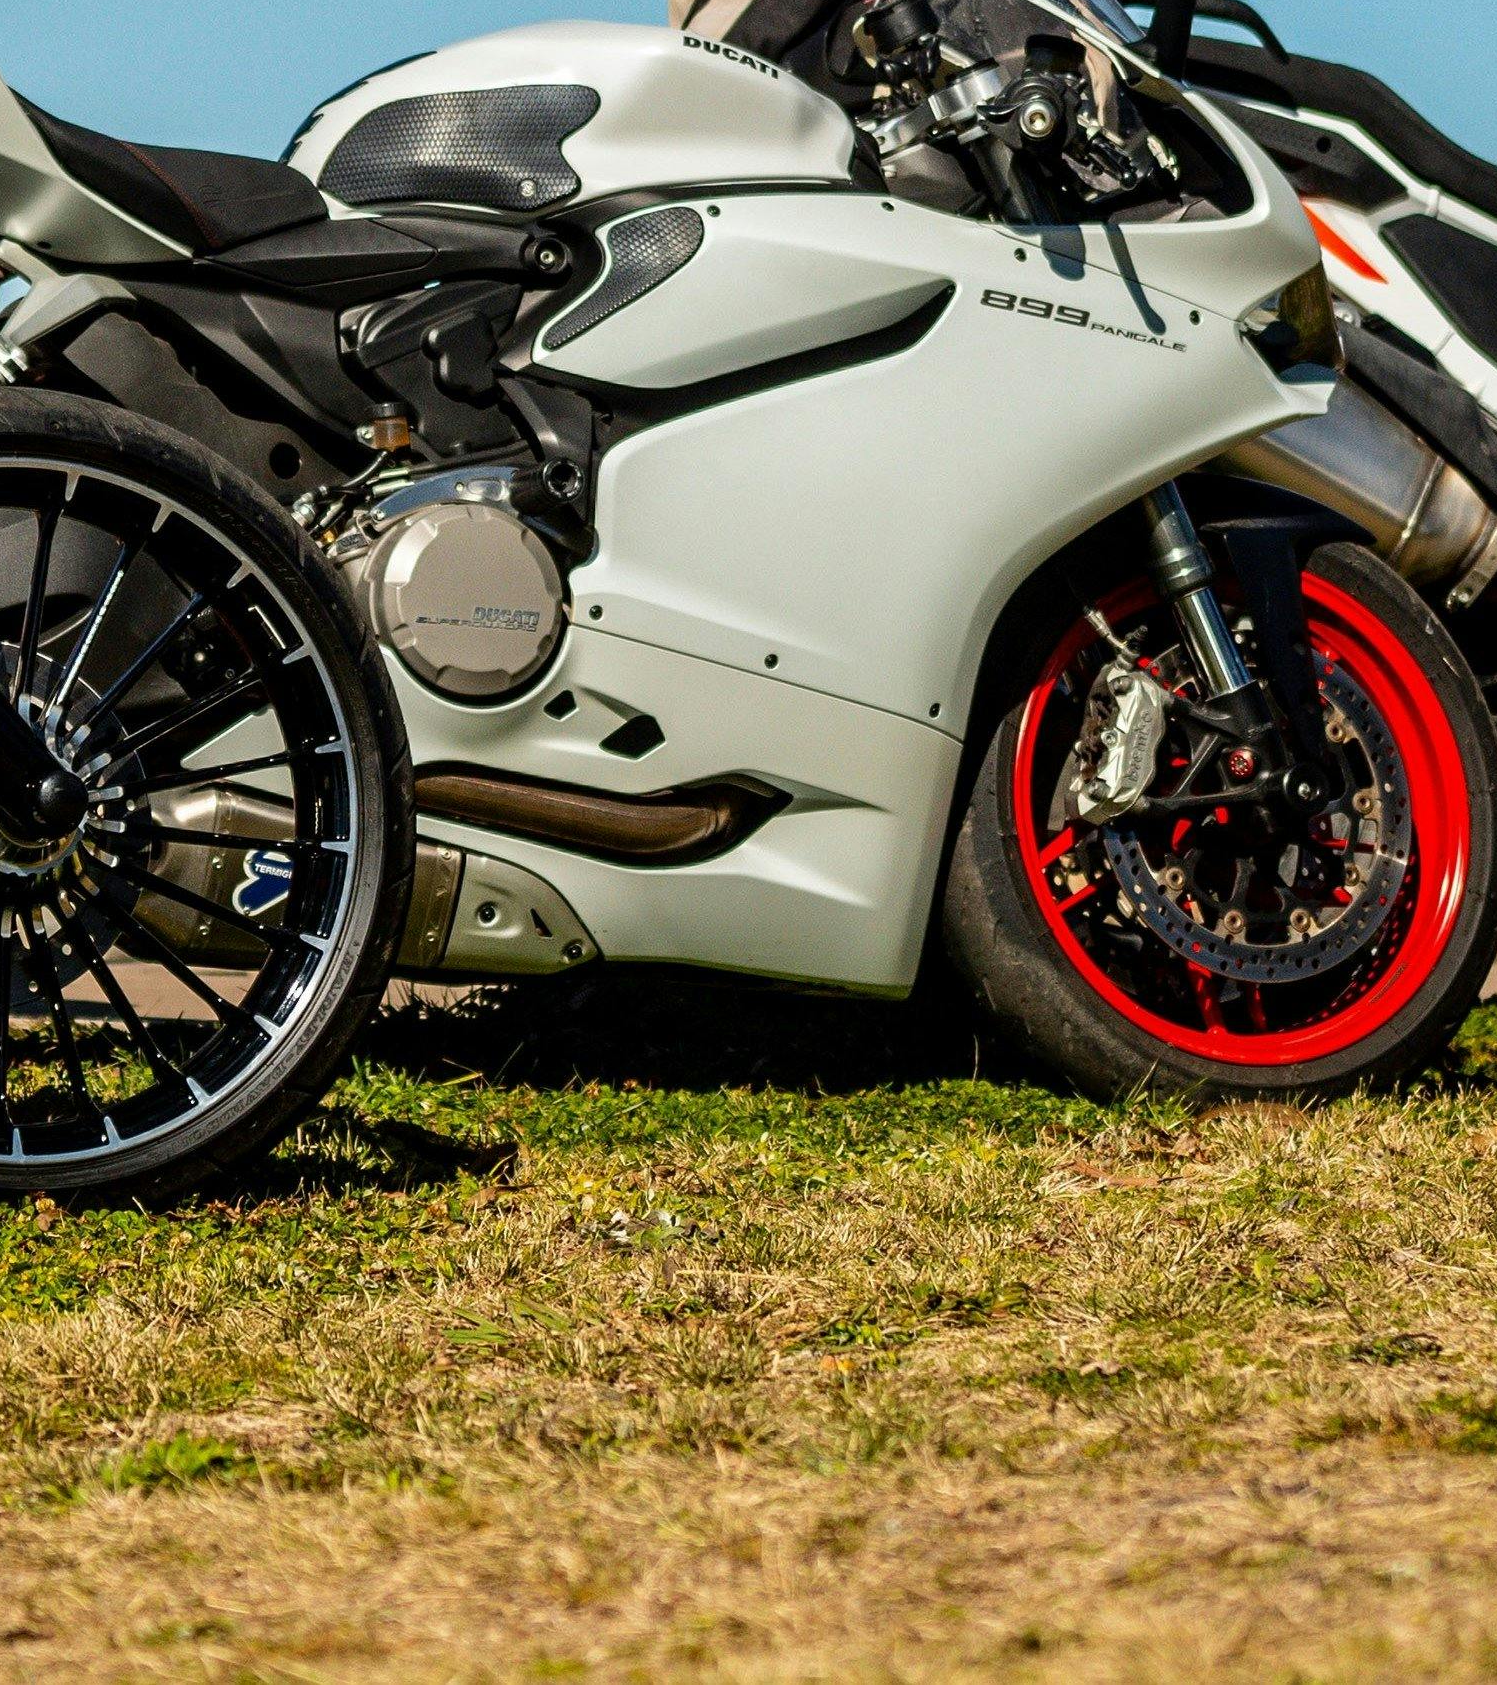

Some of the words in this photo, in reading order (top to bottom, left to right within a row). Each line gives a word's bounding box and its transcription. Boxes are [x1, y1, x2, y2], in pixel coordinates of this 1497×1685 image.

[682, 35, 780, 80] DUCATI
[980, 288, 1091, 328] 899
[1091, 322, 1188, 353] PANIGALE
[473, 606, 541, 626] DUCATI
